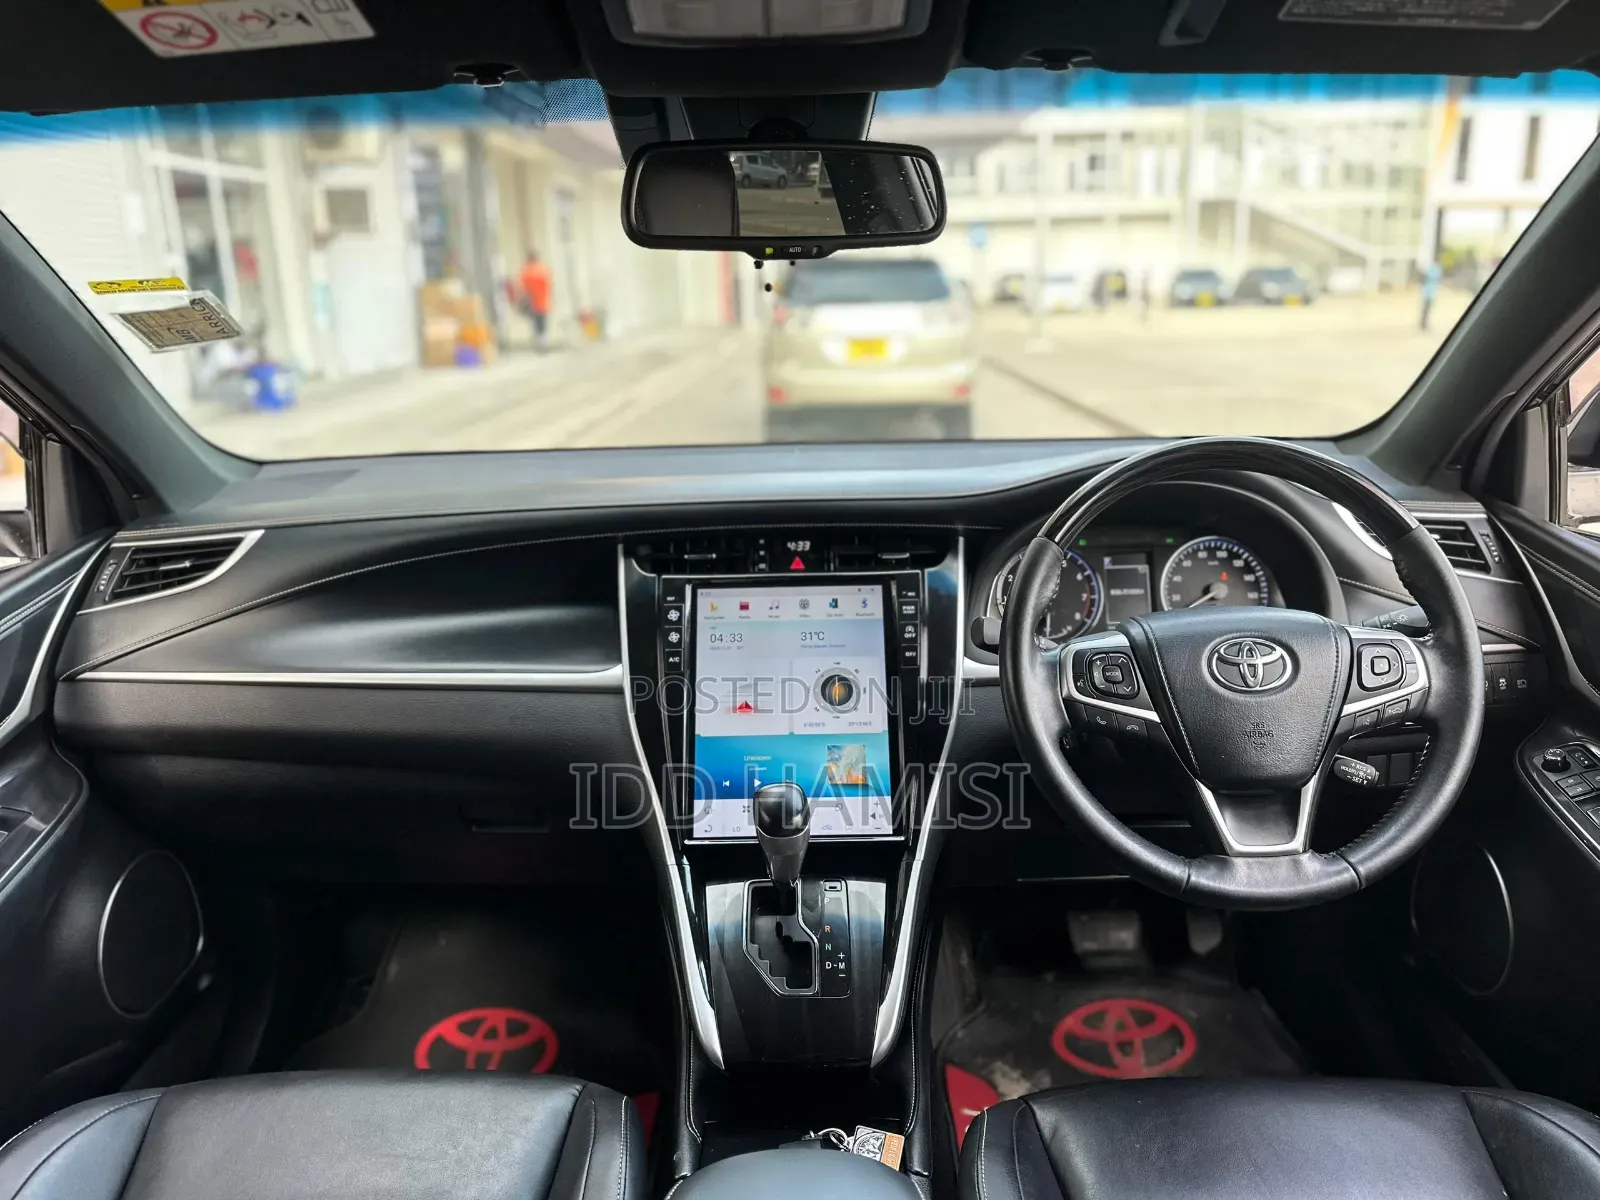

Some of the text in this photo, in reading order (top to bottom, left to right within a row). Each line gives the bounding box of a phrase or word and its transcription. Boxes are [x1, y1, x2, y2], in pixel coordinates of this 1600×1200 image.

[787, 540, 811, 552] 4:33
[1062, 560, 1068, 568] 5
[710, 632, 743, 644] 04:33
[800, 631, 825, 642] 31°C
[1241, 730, 1274, 739] AIRBAG
